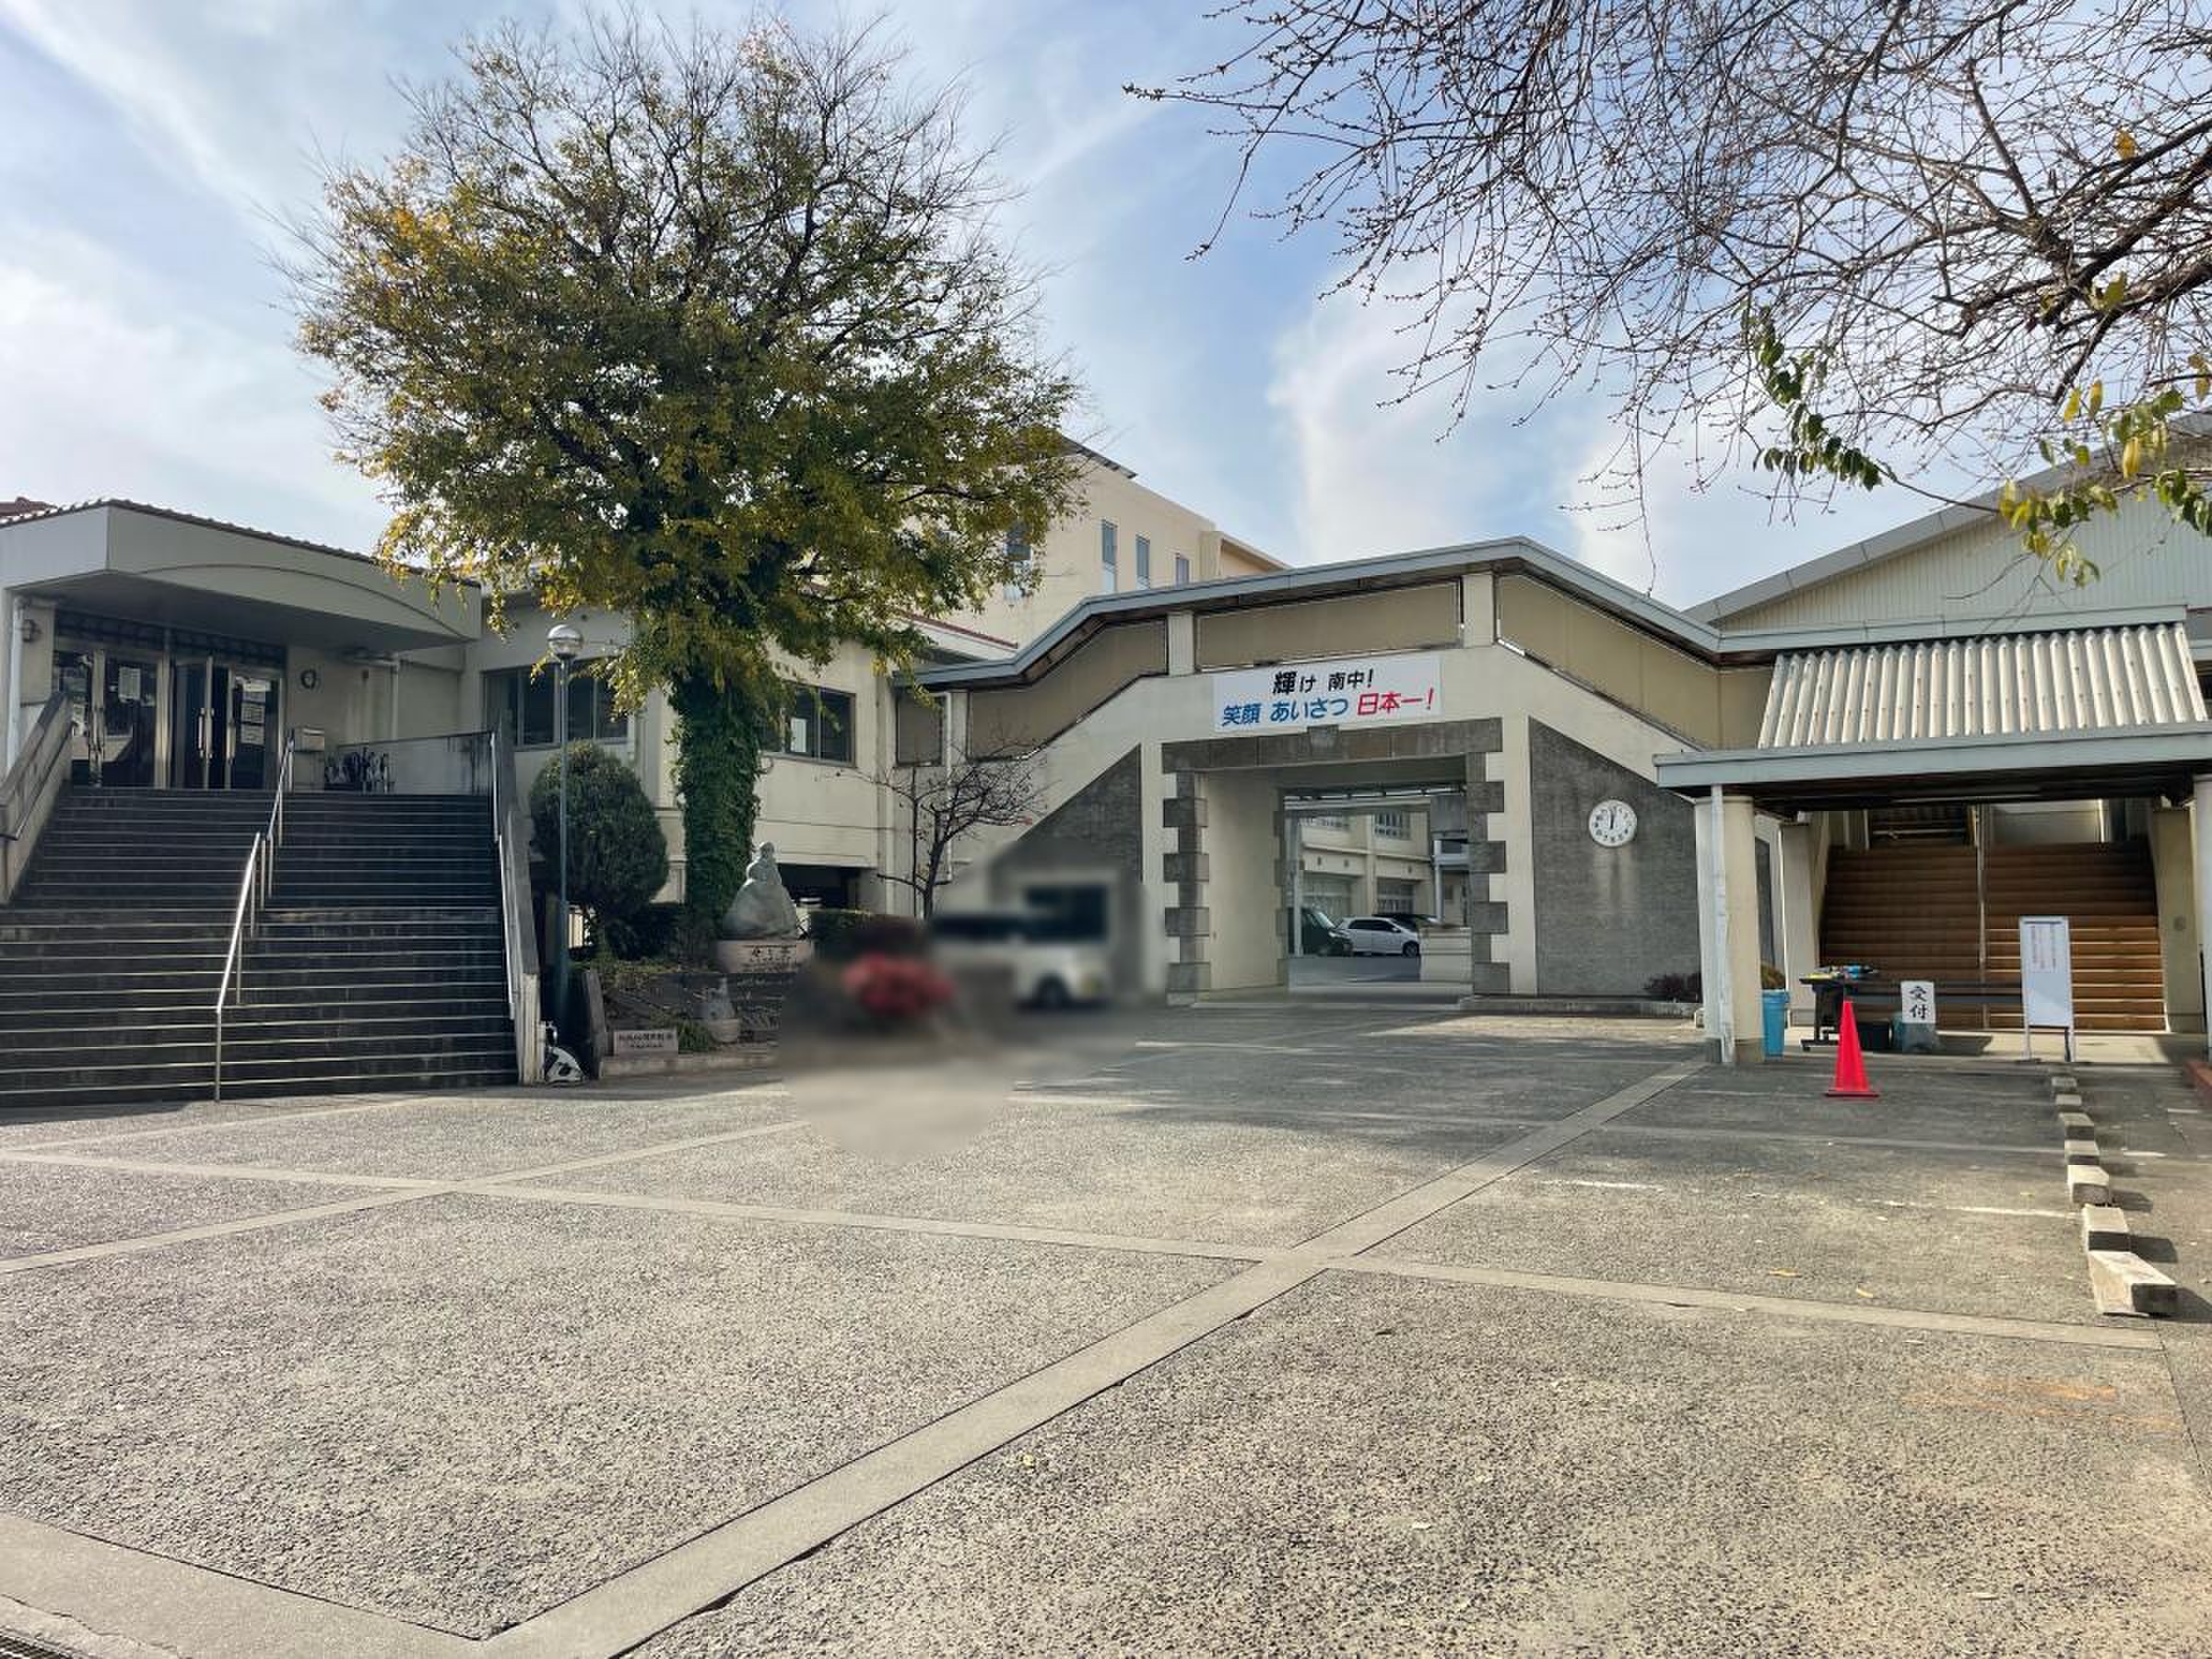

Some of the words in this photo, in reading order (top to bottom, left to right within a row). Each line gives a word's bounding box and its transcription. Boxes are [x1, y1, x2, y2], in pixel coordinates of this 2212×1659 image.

[1273, 671, 1316, 695] 輝け
[1222, 704, 1261, 726] 笑顔
[1270, 698, 1348, 723] あいさつ
